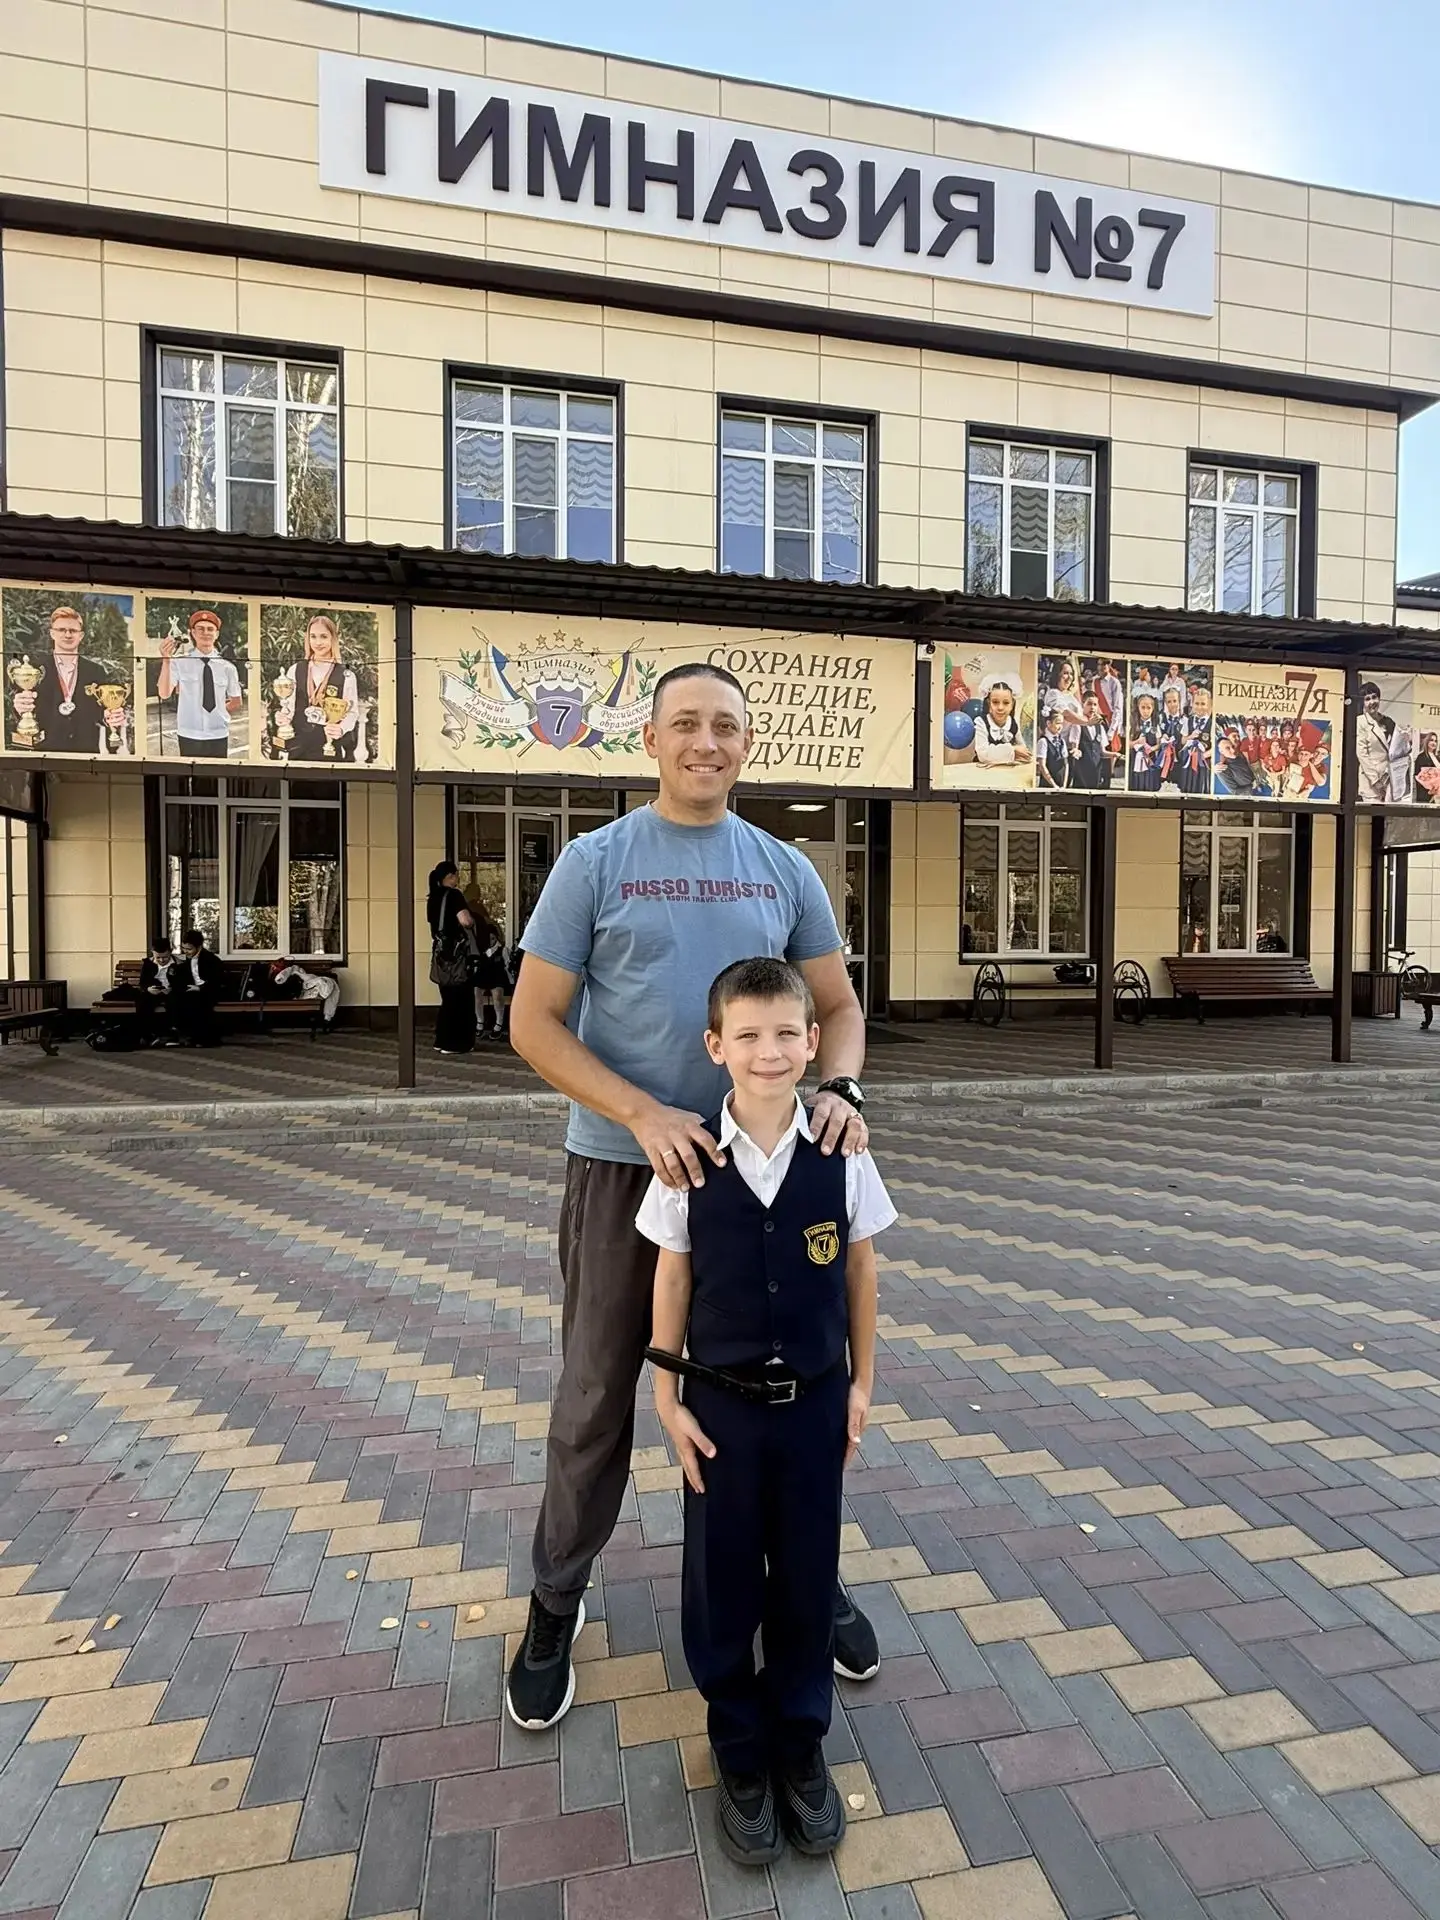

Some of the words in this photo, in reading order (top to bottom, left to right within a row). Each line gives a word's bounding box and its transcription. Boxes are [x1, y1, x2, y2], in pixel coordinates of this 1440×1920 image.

[364, 77, 996, 266] ГИМНАЗИЯ
[1034, 188, 1187, 291] №7
[521, 657, 596, 677] Гимназия
[706, 648, 873, 681] СОХРАНЯЯ
[463, 701, 511, 725] традиции
[745, 680, 877, 715] СЛЕДИЕ,
[1249, 701, 1298, 713] ДРУЖНА
[550, 704, 572, 736] 7
[747, 710, 865, 741] ЗДАЁМ
[748, 741, 865, 772] ДУЩЕЕ
[620, 878, 690, 900] RUSSO
[818, 1236, 828, 1251] 7
